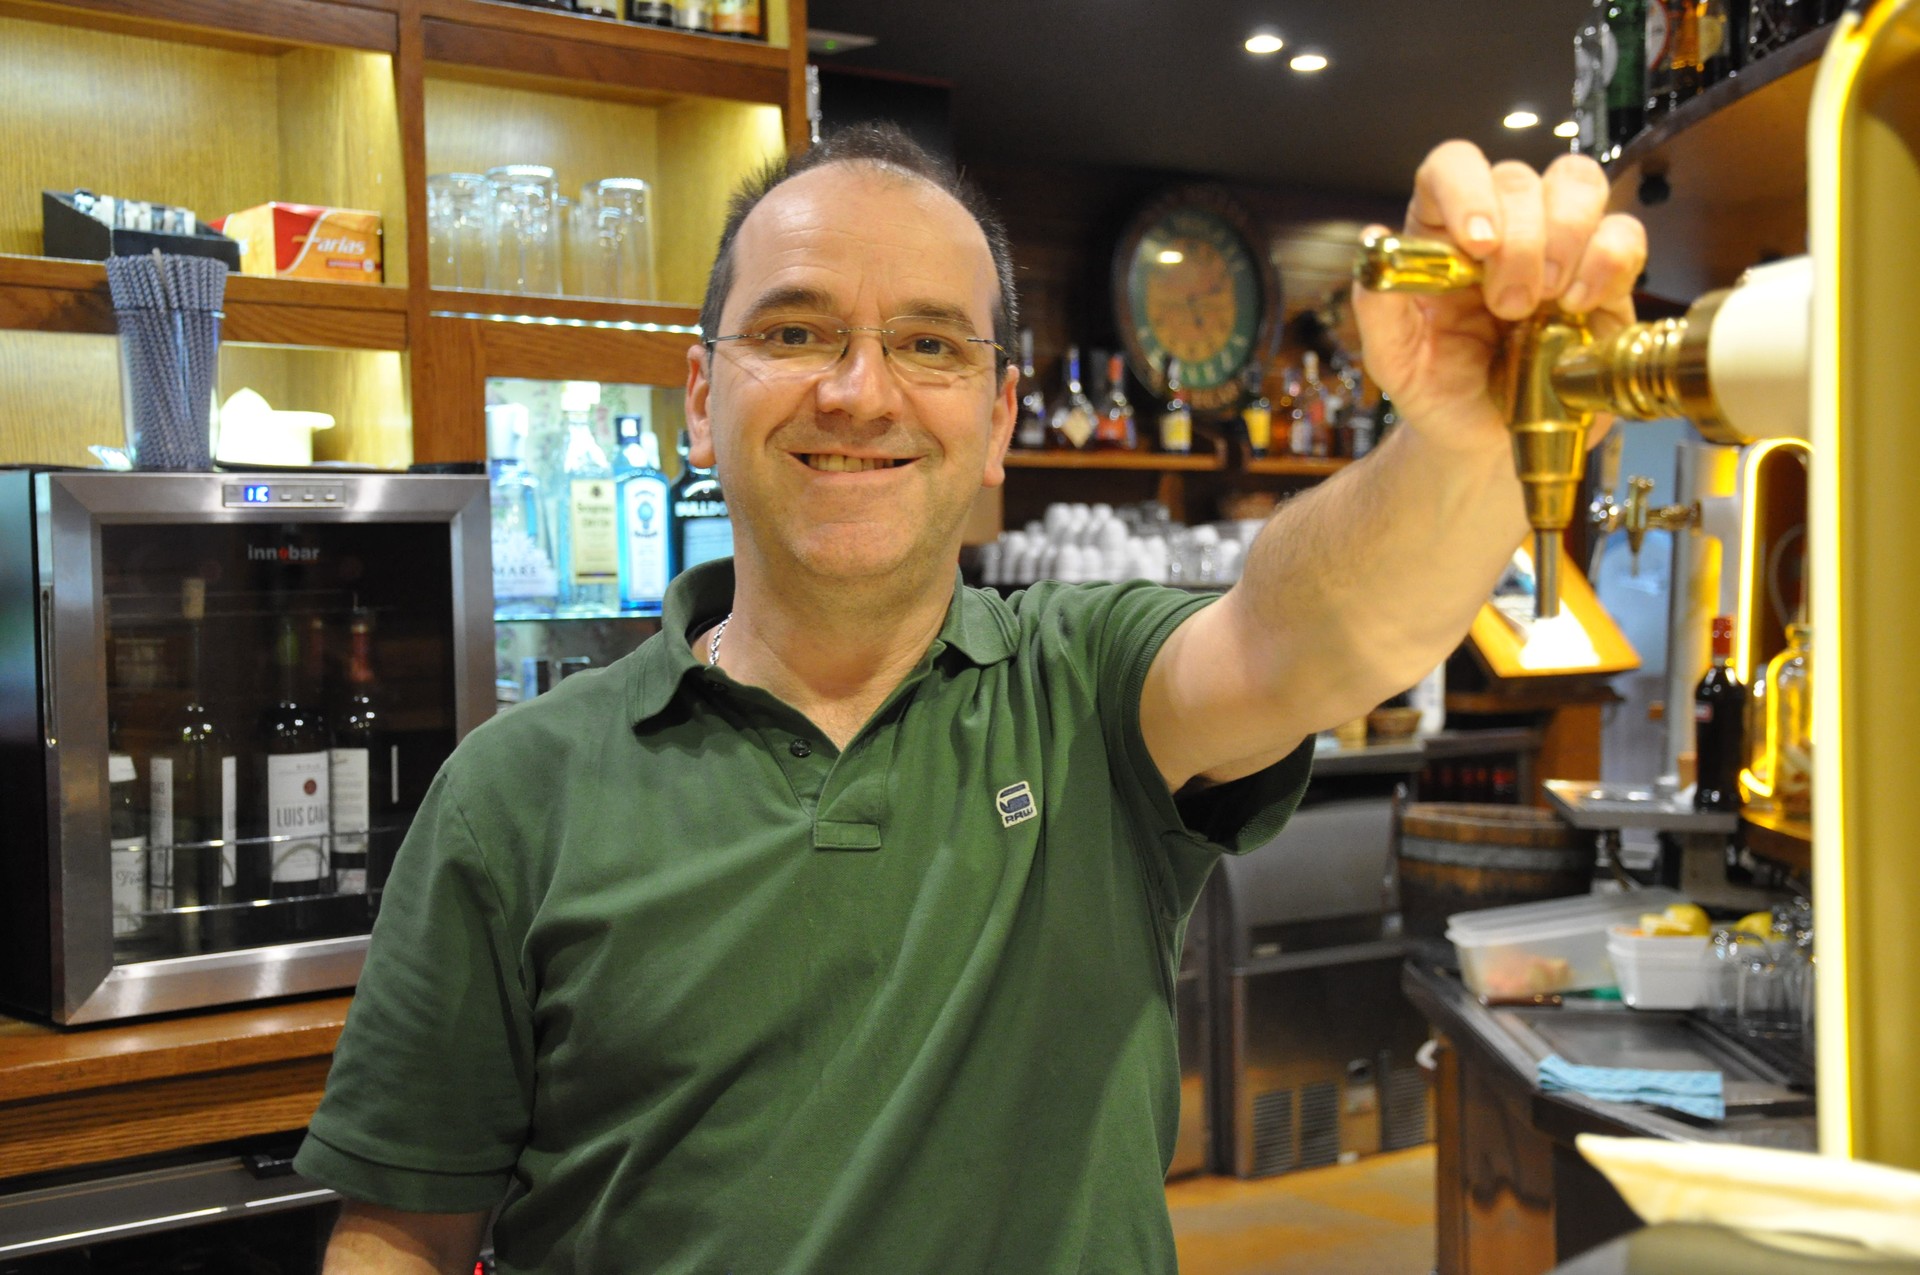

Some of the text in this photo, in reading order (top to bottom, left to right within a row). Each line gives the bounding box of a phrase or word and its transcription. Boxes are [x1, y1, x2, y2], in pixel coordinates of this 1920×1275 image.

[247, 544, 320, 560] innobar
[276, 806, 304, 828] LUIS
[1004, 807, 1034, 824] RAW
